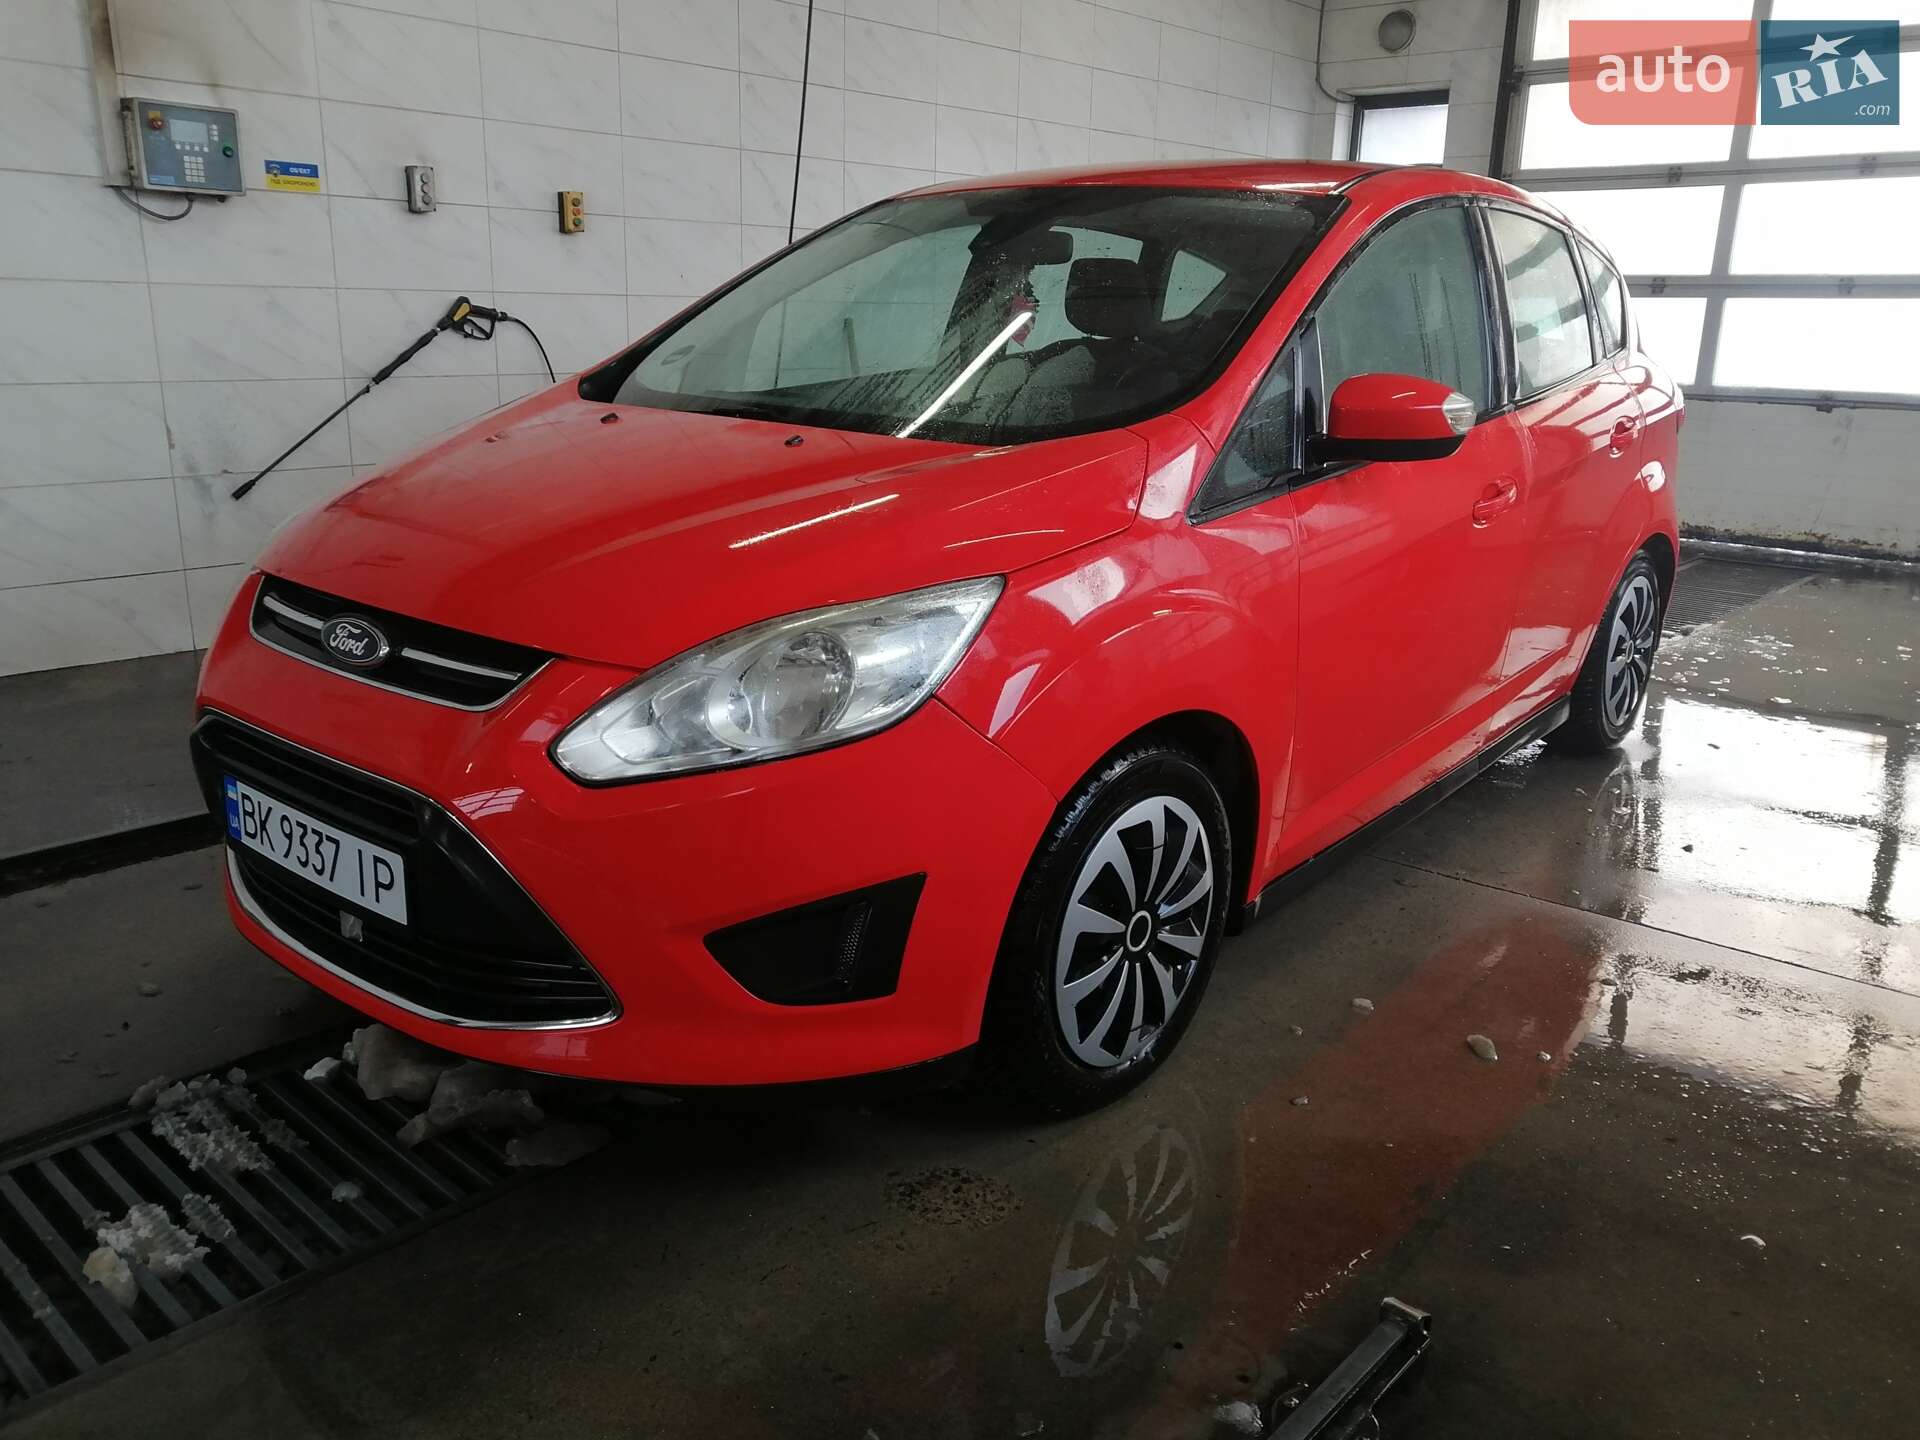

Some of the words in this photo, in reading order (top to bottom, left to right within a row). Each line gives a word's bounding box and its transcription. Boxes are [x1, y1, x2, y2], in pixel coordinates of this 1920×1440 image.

[329, 623, 369, 656] Ford
[241, 791, 275, 853] BK
[279, 814, 340, 882] 9337
[357, 848, 395, 904] IP
